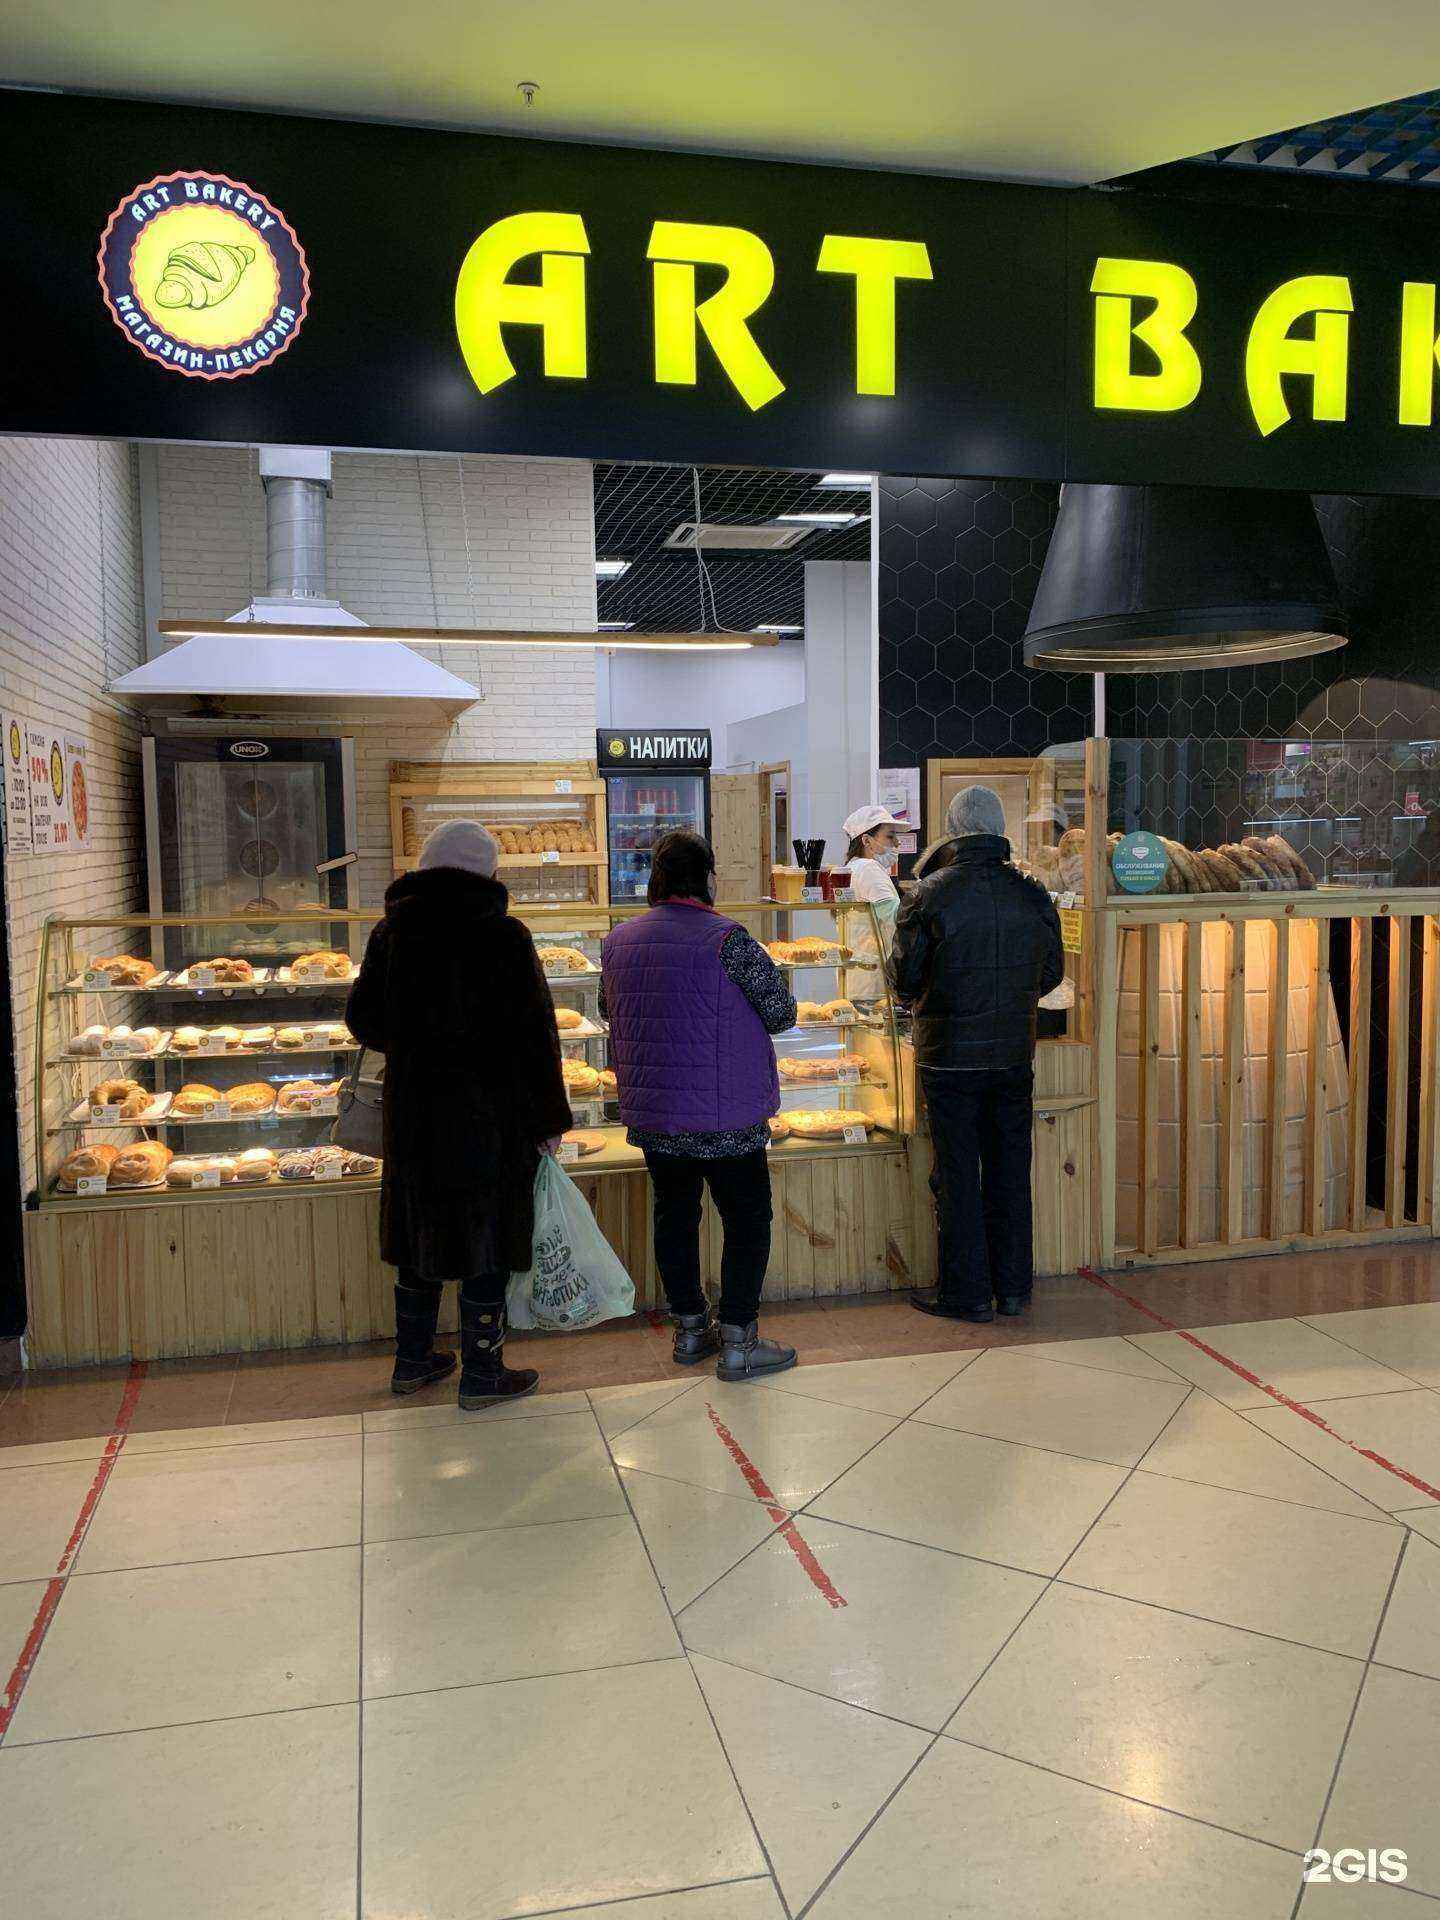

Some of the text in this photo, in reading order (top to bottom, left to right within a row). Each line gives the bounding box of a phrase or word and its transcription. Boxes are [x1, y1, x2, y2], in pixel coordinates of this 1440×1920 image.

[131, 182, 275, 230] ART BAKERY
[116, 295, 296, 370] МАГАЗИН-ПЕКАРНЯ
[455, 212, 933, 411] ART
[629, 737, 708, 759] НАПИТКИ
